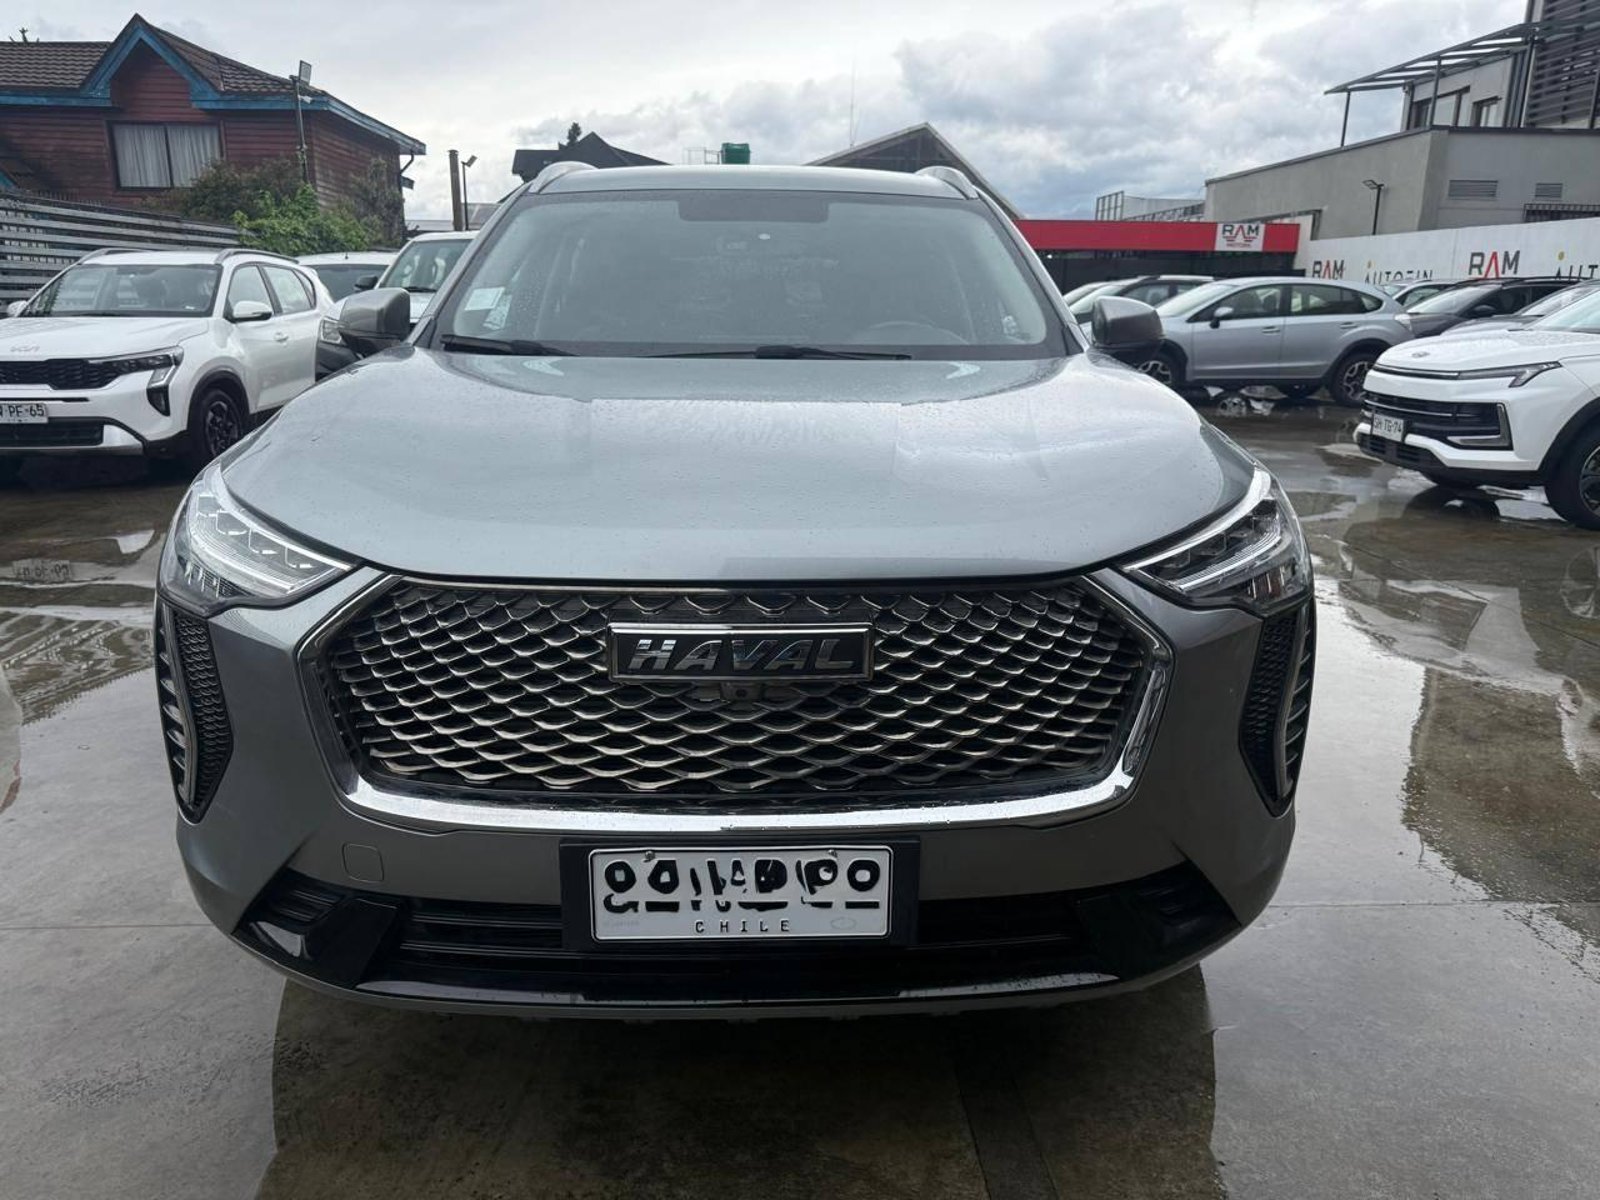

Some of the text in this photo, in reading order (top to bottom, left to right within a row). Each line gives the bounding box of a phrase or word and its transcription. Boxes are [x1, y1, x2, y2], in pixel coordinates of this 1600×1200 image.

[1221, 224, 1260, 239] RAM
[1311, 259, 1345, 280] RAM
[1467, 250, 1521, 280] RAM
[628, 638, 854, 671] HAVAL
[695, 920, 790, 933] CHILE
